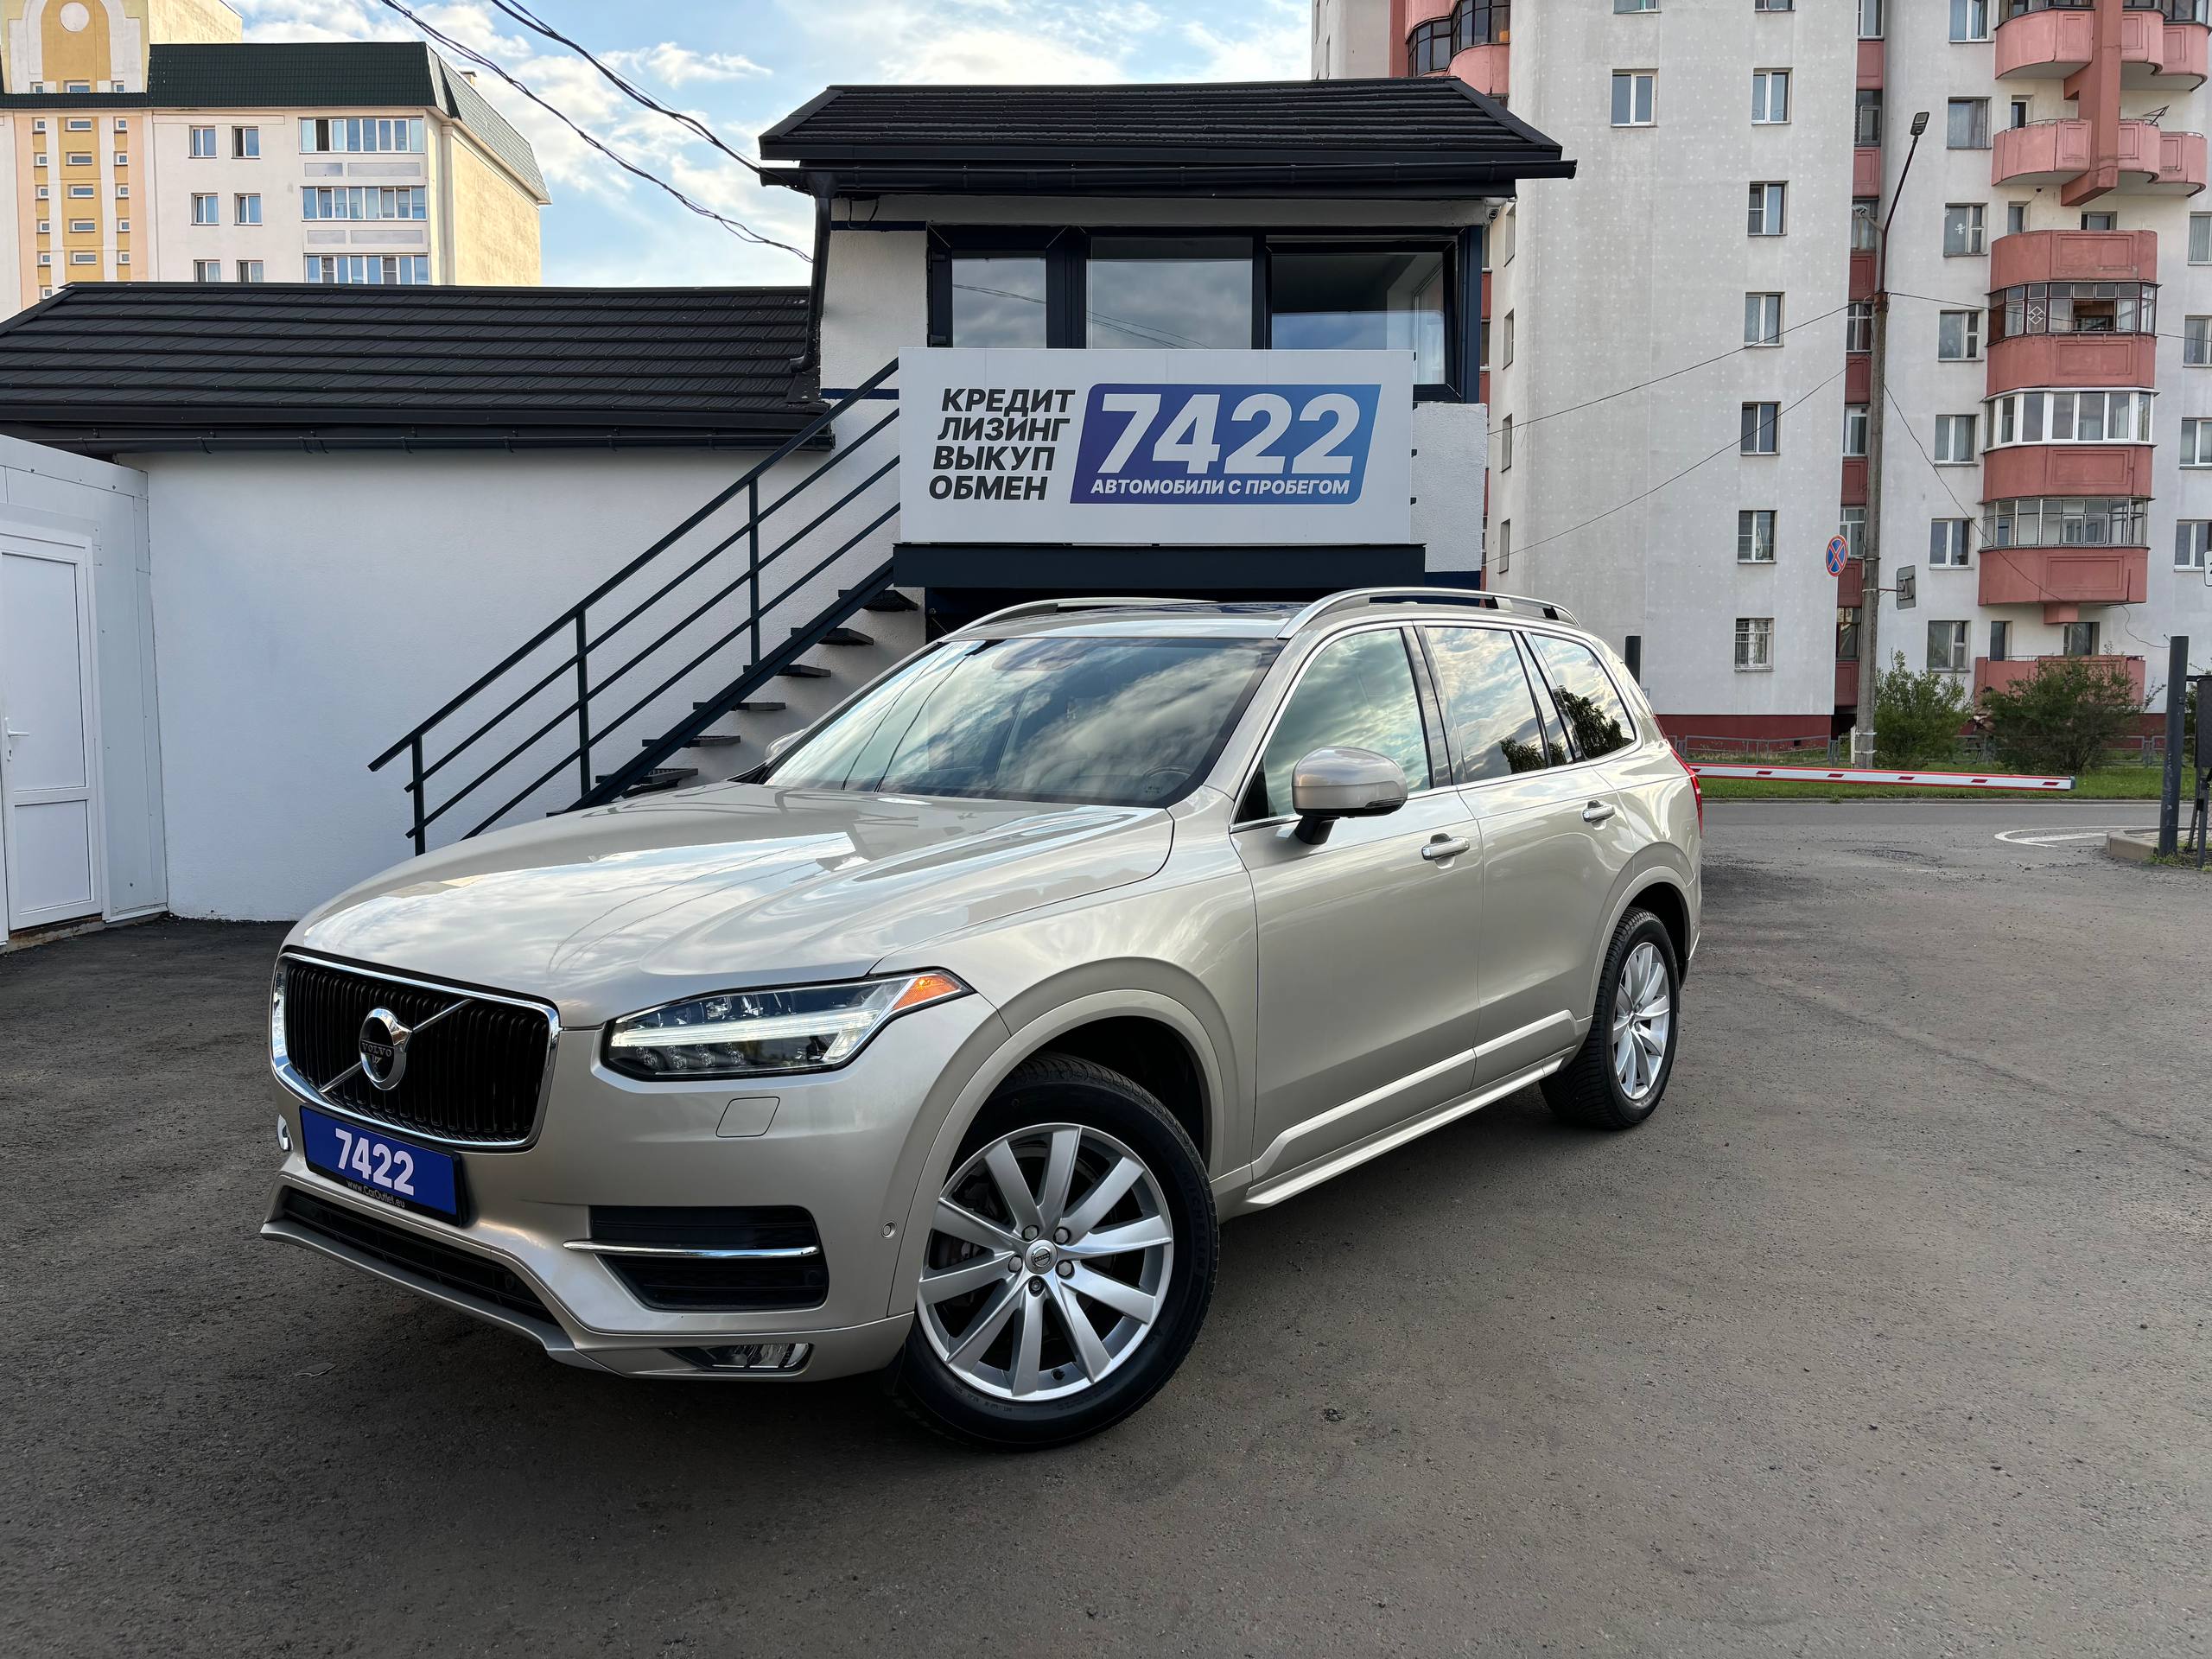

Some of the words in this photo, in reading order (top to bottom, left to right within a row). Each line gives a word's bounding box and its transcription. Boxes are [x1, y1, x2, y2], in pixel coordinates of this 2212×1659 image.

[941, 388, 1076, 417] КРЕДИТ
[937, 417, 1071, 442] ЛИЗИНГ
[1097, 393, 1361, 474] 7422
[932, 446, 1056, 471] ВЫКУП
[929, 475, 1048, 500] ОБМЕН
[1090, 479, 1225, 495] АВТОМОБИЛИ
[1227, 479, 1242, 495] С
[1244, 479, 1350, 495] ПРОБЕГОМ
[361, 1042, 392, 1058] VOLVO
[335, 1127, 415, 1197] 7422
[346, 1179, 405, 1208] www.CarOutlet.eu
